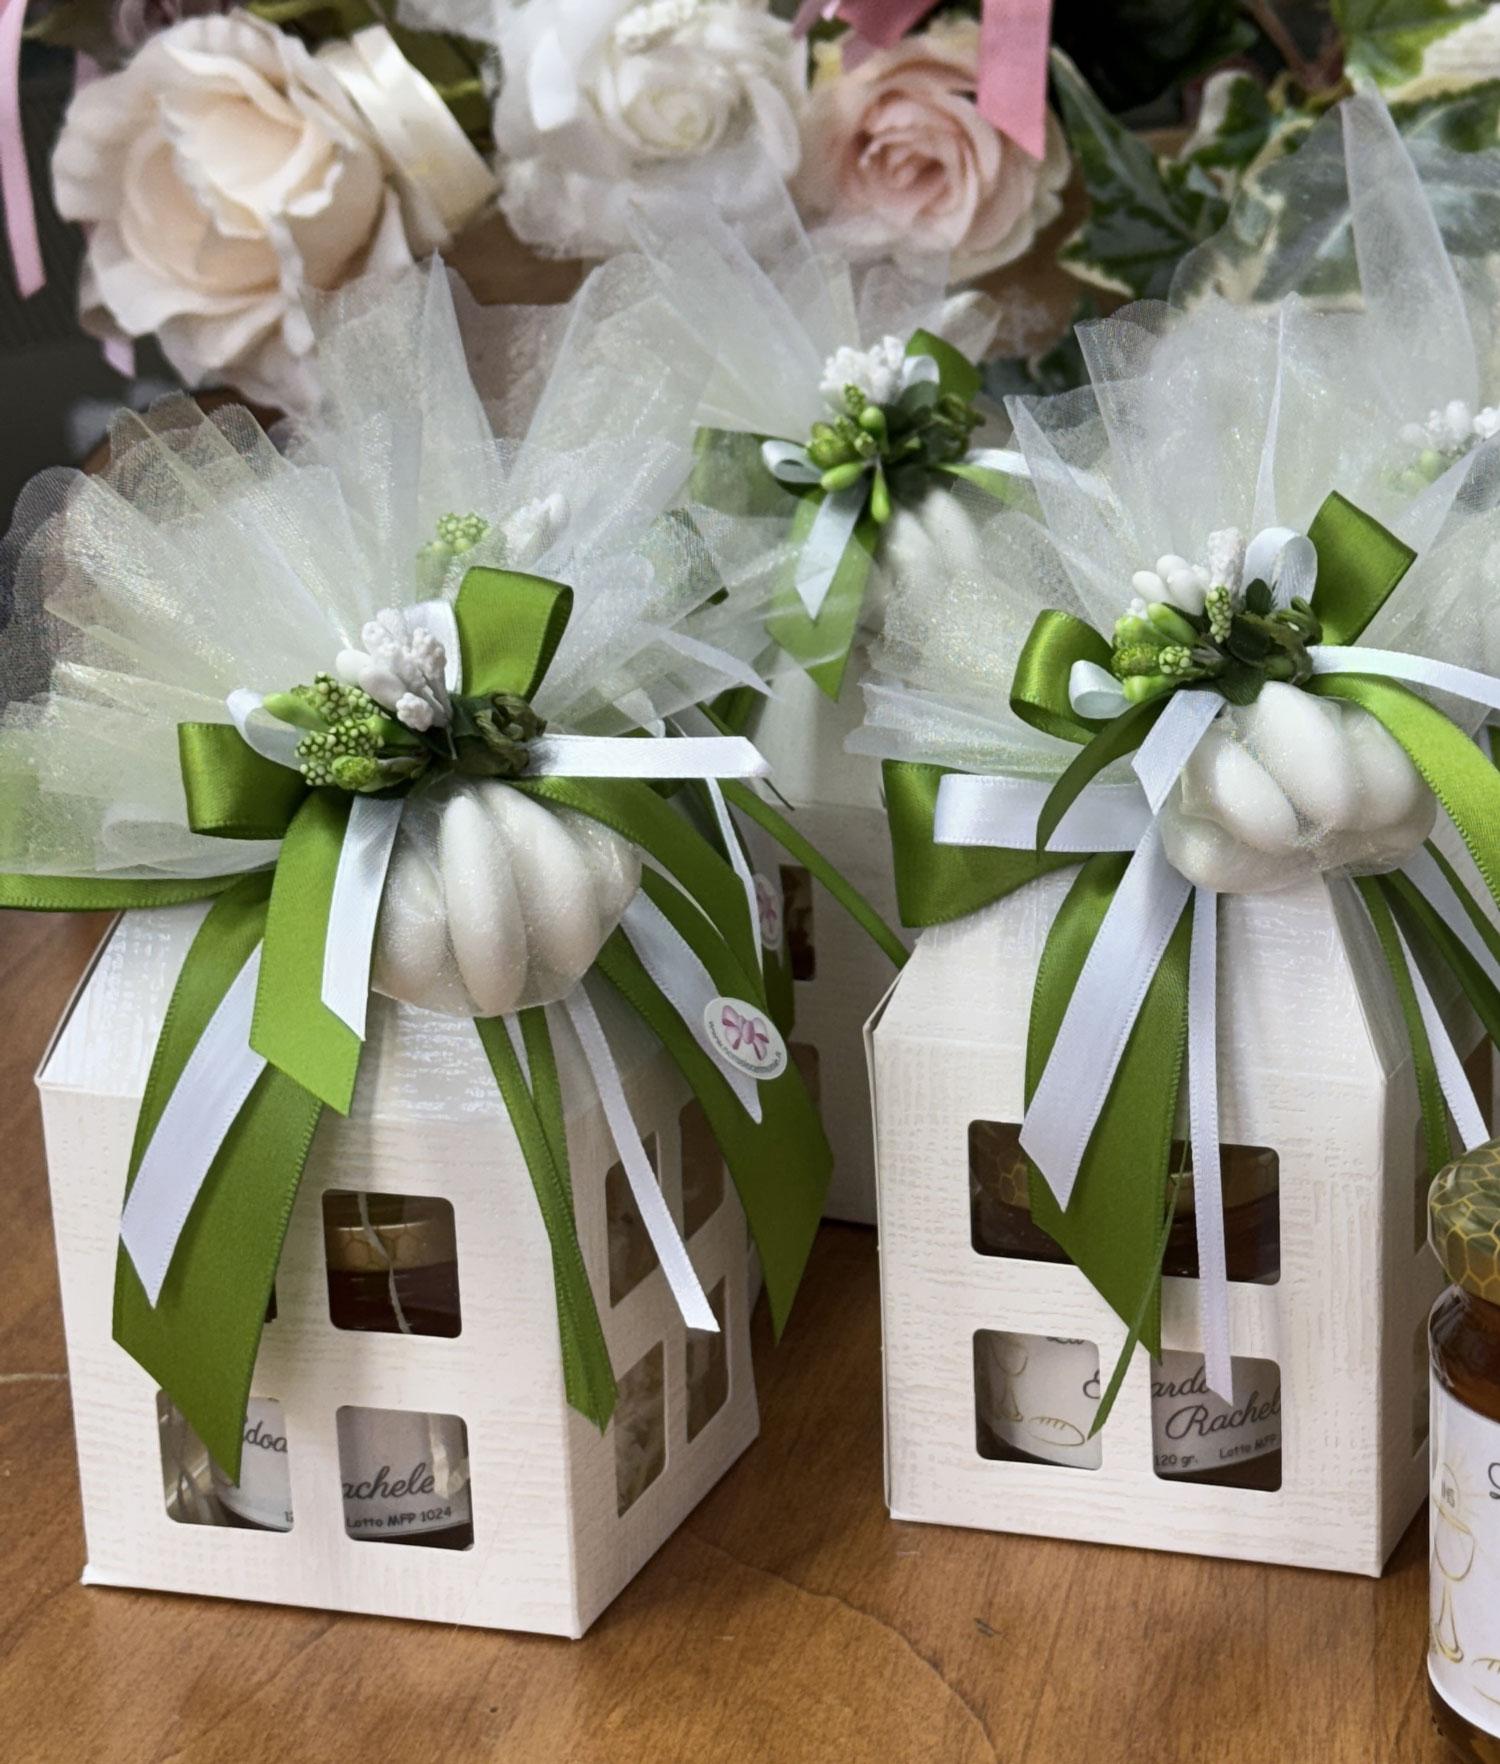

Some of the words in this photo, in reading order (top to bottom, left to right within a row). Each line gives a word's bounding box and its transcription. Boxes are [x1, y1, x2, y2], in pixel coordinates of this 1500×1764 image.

[1154, 1454, 1178, 1466] 120
[346, 1516, 383, 1527] Lotto
[387, 1512, 416, 1527] MFP
[421, 1506, 452, 1522] 1024
